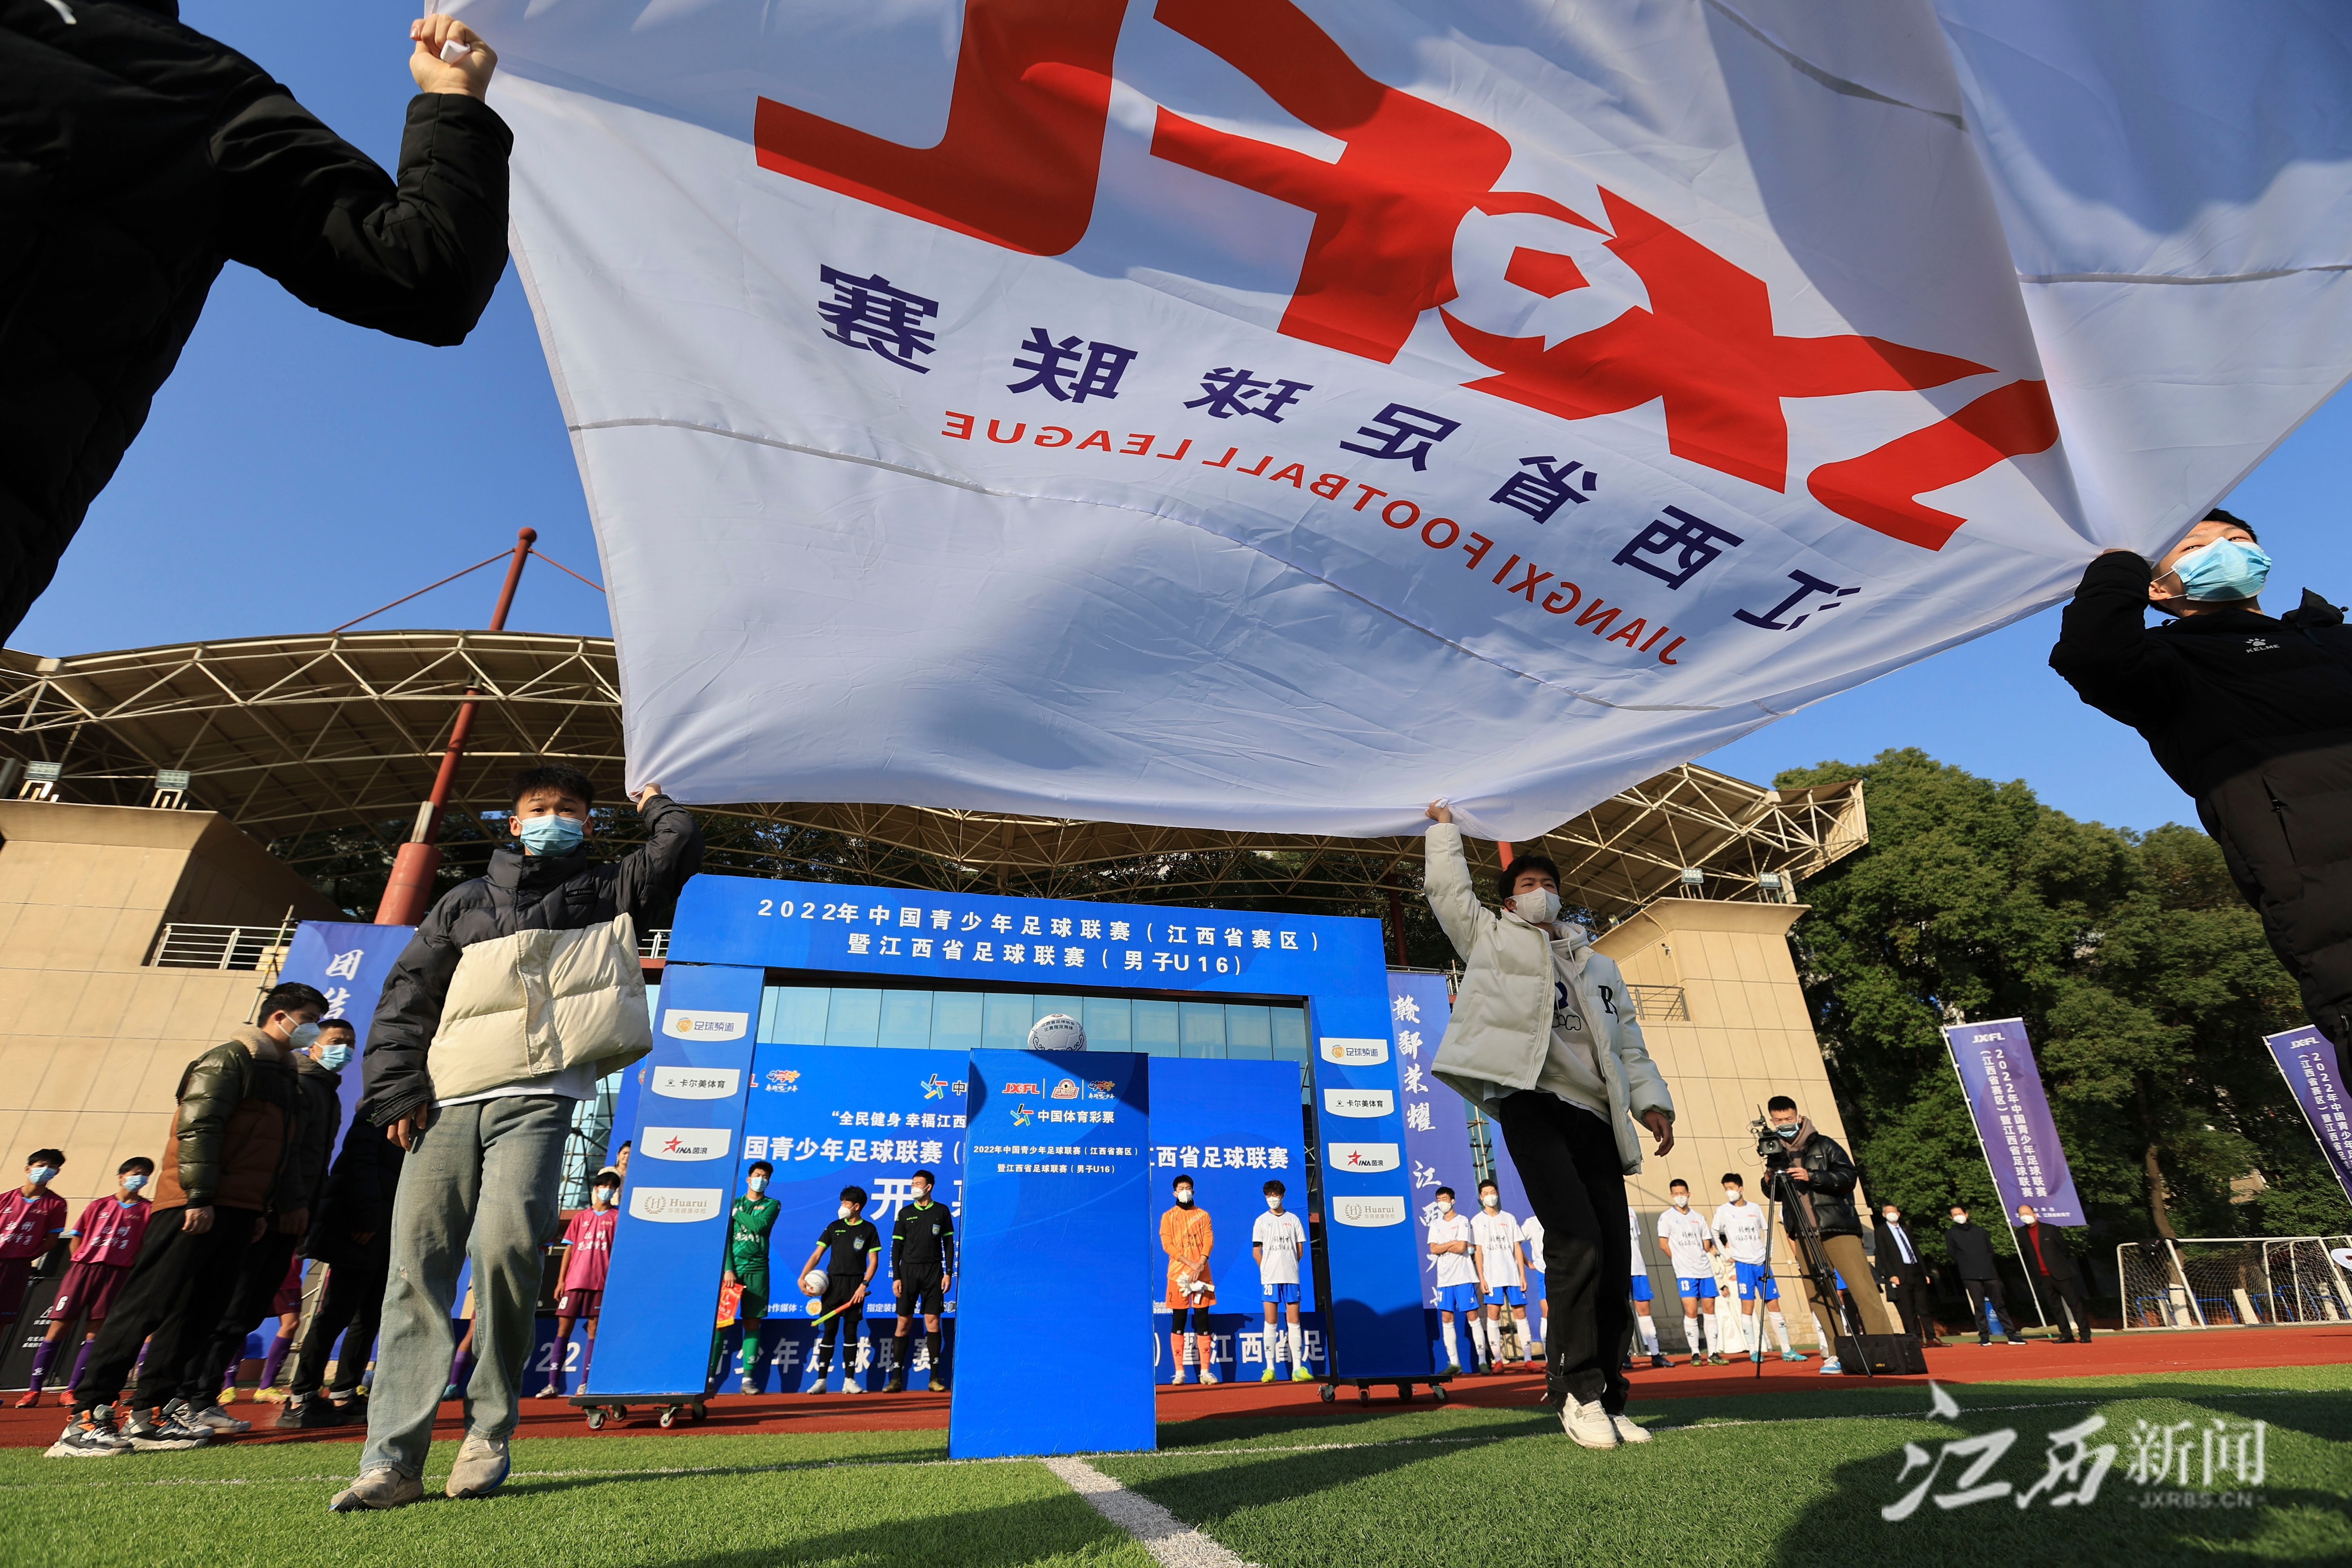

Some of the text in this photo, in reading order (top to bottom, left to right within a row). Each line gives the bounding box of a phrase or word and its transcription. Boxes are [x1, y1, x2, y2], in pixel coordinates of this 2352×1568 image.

[2246, 644, 2280, 653] KELME
[693, 1021, 734, 1032] 足球频道
[1972, 1032, 2005, 1044] JXFL
[2290, 1037, 2320, 1049] JXFL
[1346, 1047, 1379, 1056] 足球频道
[1393, 995, 1436, 1132] 赣鄱荣耀
[680, 1078, 726, 1089] 卡尔美体育
[1002, 1083, 1040, 1094] JXFL
[1347, 1100, 1383, 1108] 卡尔美体育
[906, 1113, 967, 1128] 幸福江西
[1038, 1110, 1114, 1123] 中国体育彩票
[670, 1199, 707, 1207] Huarui
[1264, 1284, 1273, 1296] 20
[1680, 1280, 1690, 1291] 13
[56, 1296, 69, 1311] 6
